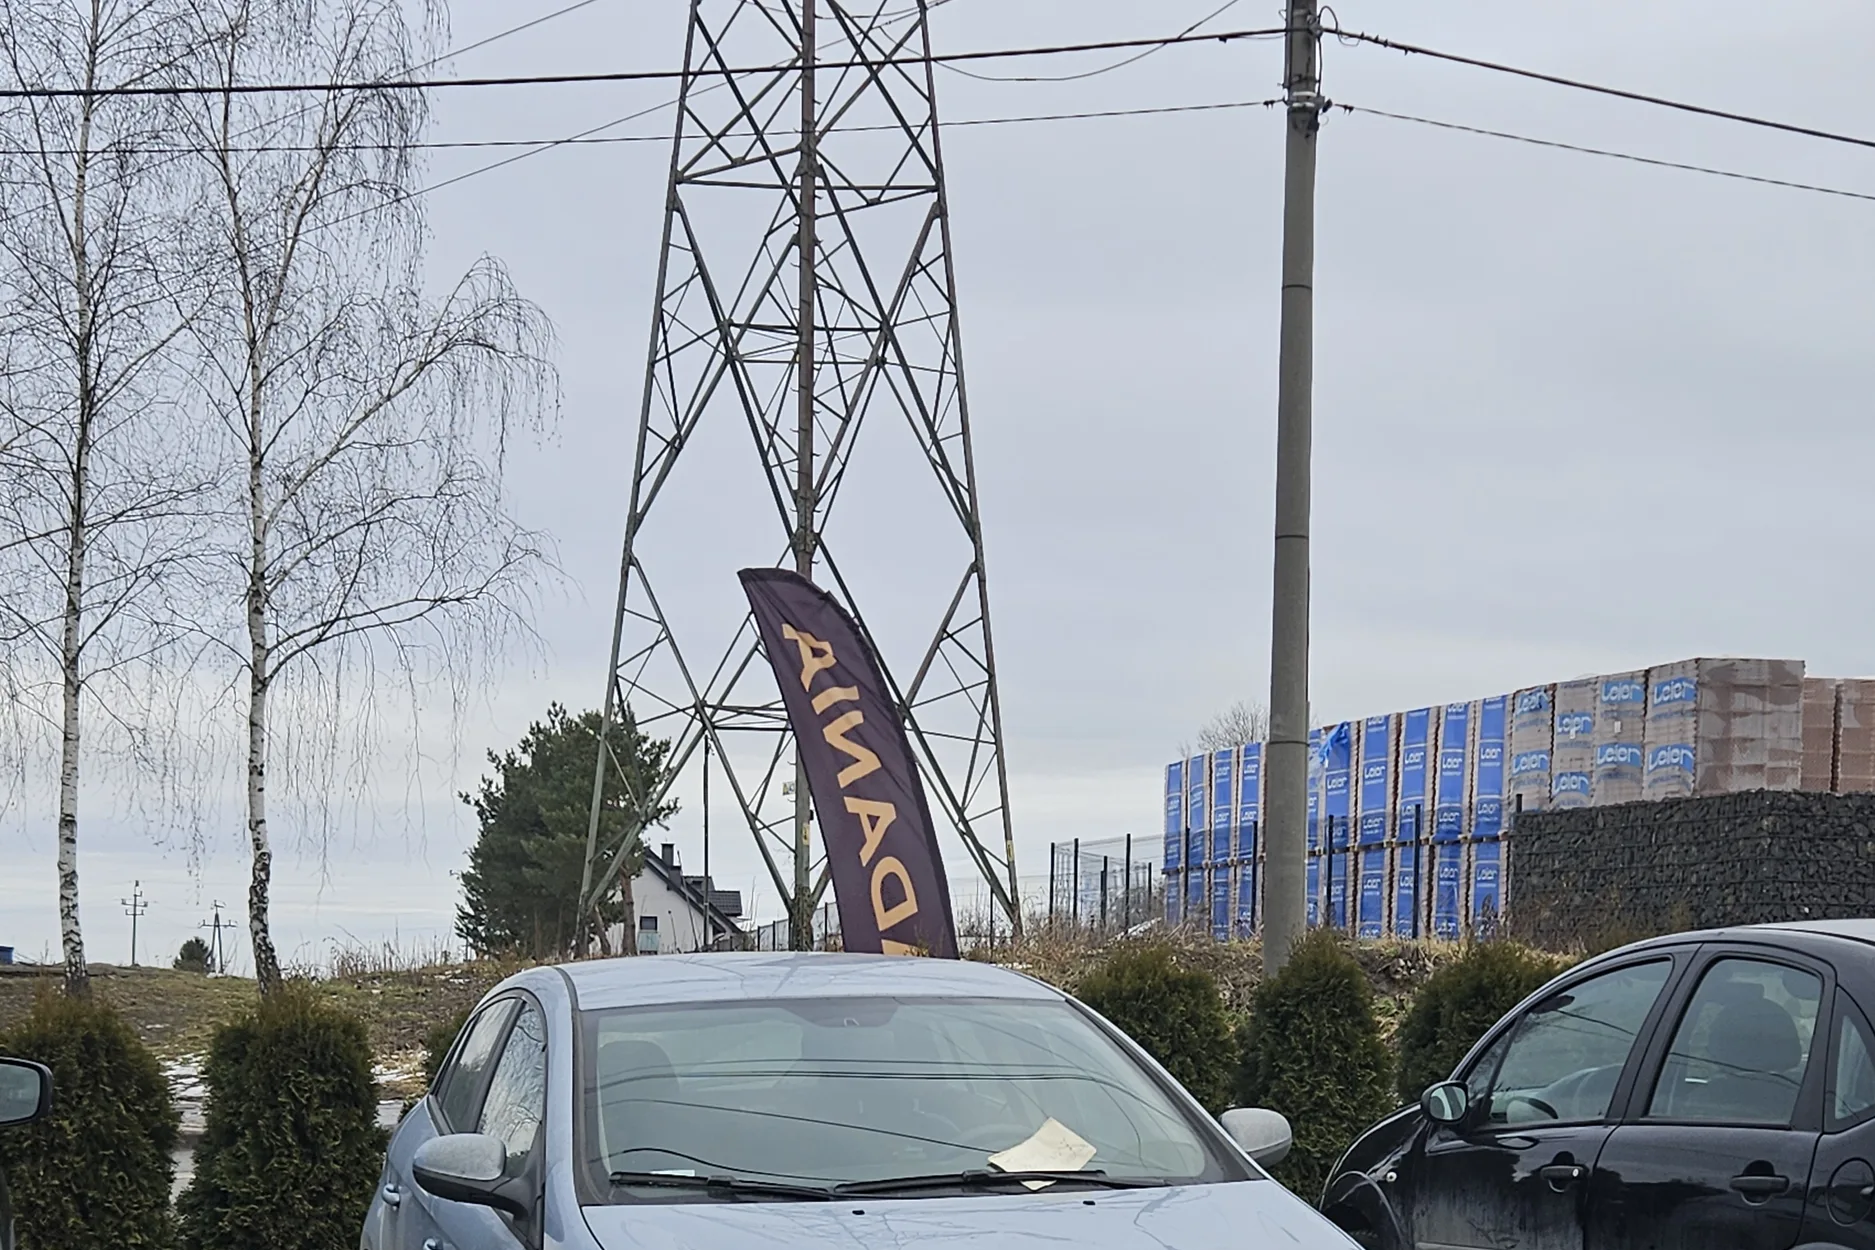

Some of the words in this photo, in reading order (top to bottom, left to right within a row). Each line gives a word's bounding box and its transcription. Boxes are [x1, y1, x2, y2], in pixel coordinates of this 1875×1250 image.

[1602, 682, 1641, 702] Leier
[1652, 681, 1695, 705] Leier
[1597, 744, 1641, 765] Leier
[1648, 745, 1694, 772] Leier
